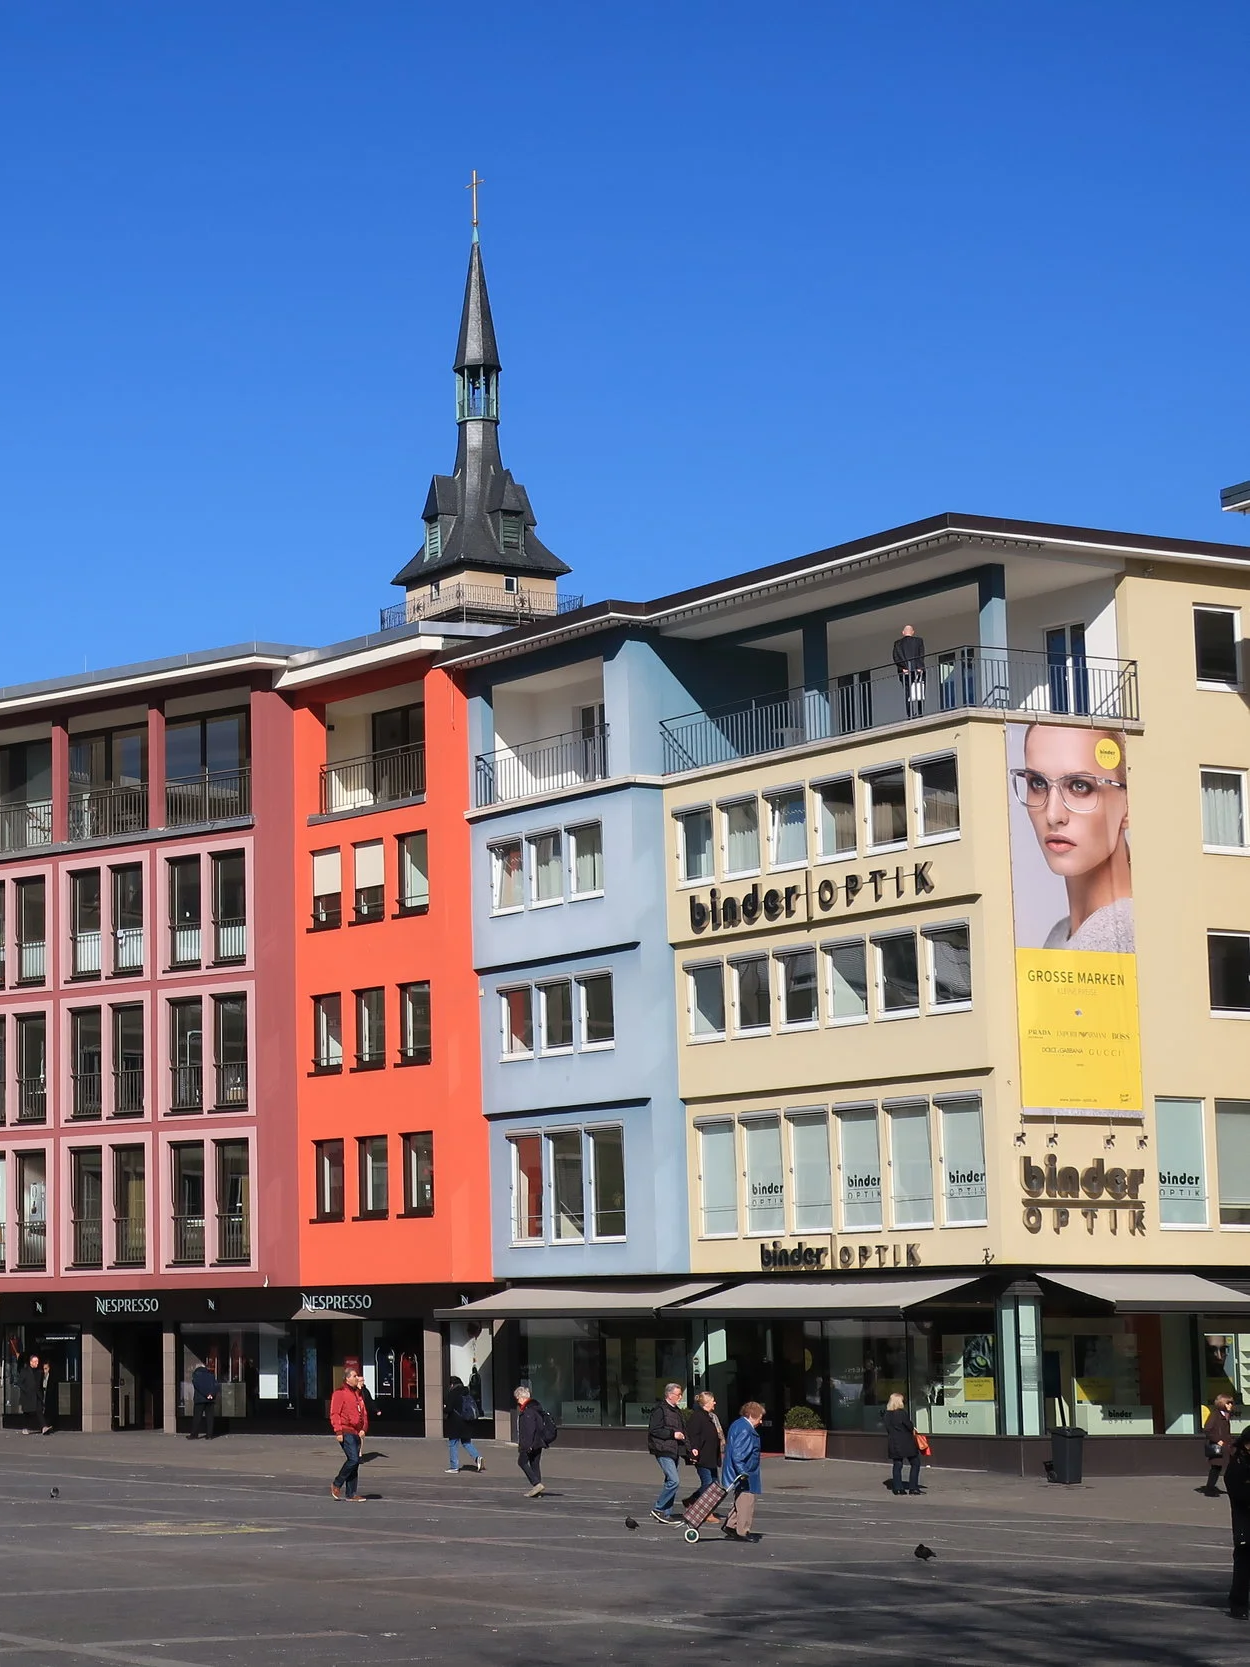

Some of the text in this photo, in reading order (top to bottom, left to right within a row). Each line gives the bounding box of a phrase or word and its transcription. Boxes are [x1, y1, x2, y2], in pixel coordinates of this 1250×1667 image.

[690, 861, 933, 934] binder OPTIK
[1028, 970, 1125, 986] GROSSE MARKEN
[1089, 1048, 1121, 1057] GUCCI
[848, 1175, 880, 1187] binder
[949, 1170, 985, 1183] binder
[1020, 1153, 1145, 1200] binder
[1159, 1172, 1200, 1185] binder
[752, 1183, 783, 1195] binder
[1023, 1208, 1146, 1236] OPTIK
[760, 1241, 921, 1271] binder OPTIK
[95, 1296, 159, 1315] NESPRESSO
[300, 1293, 372, 1313] NESPRESSO
[948, 1410, 969, 1418] binder
[1108, 1410, 1132, 1418] binder
